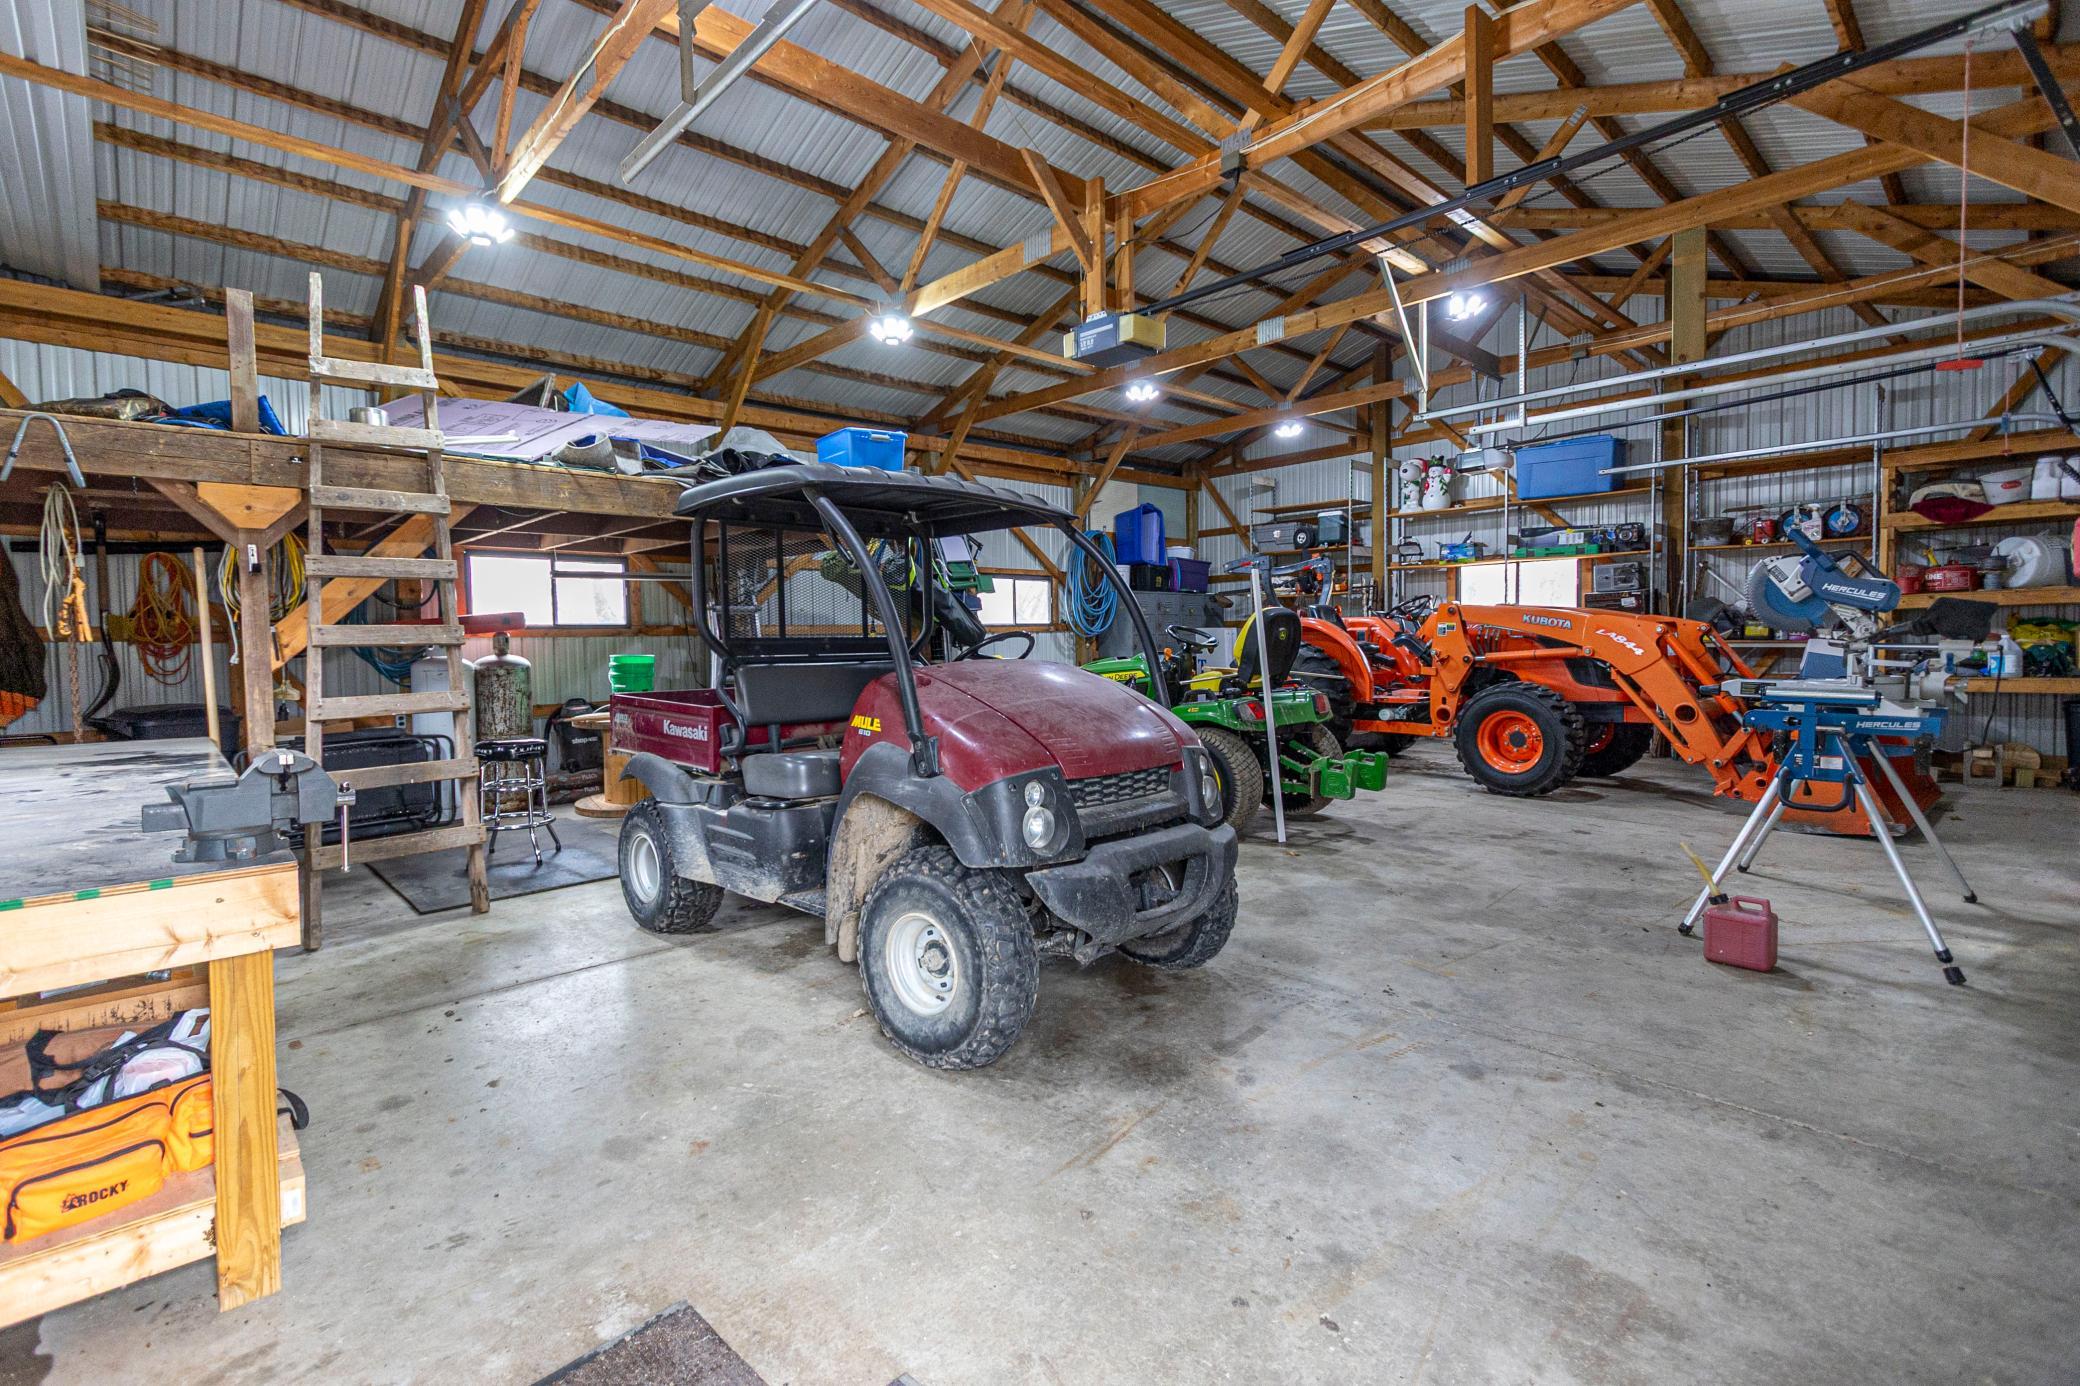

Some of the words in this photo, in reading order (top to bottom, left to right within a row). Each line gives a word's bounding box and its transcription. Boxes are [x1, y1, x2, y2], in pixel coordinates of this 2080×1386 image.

[1821, 582, 1887, 600] HERCULES
[1522, 614, 1572, 630] KUBOTA
[663, 719, 708, 742] Kawasaki
[850, 714, 882, 732] MULE
[1855, 720, 1921, 730] HERCULES
[78, 1179, 129, 1207] ROCKY
